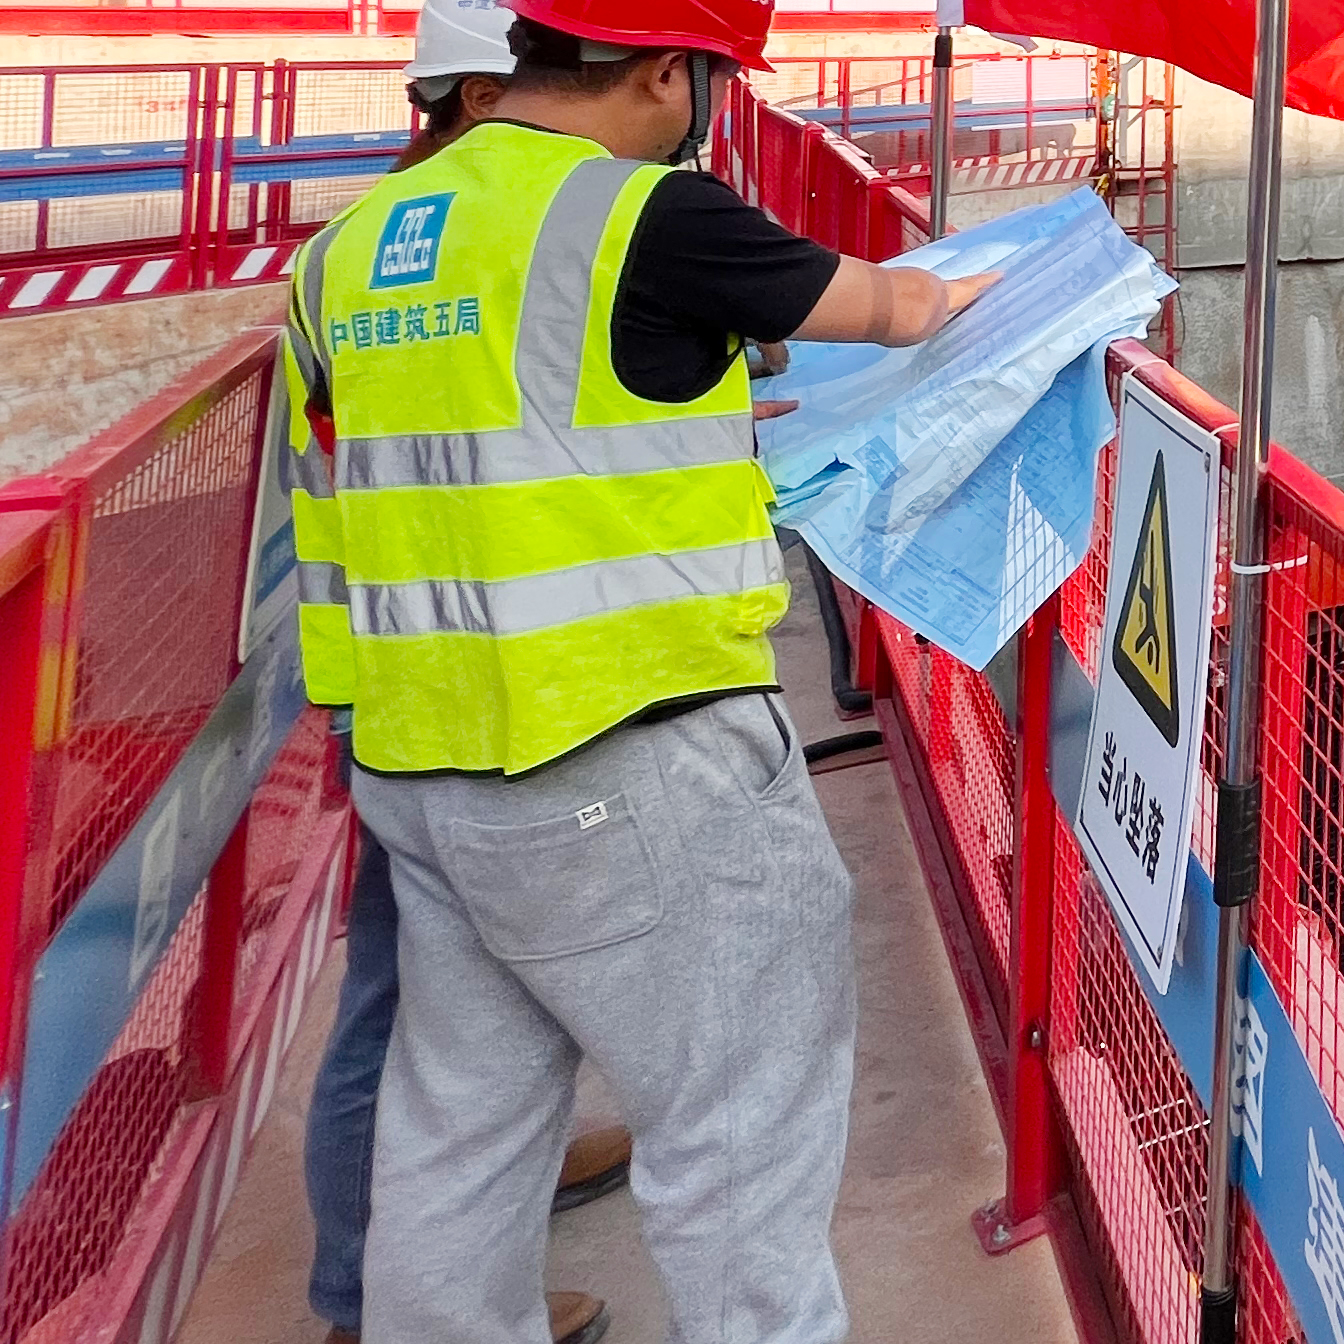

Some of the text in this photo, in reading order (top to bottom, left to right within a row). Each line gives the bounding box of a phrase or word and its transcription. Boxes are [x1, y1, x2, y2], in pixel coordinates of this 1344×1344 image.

[330, 296, 480, 355] 中国建筑五局
[1098, 731, 1165, 885] 当心坠落
